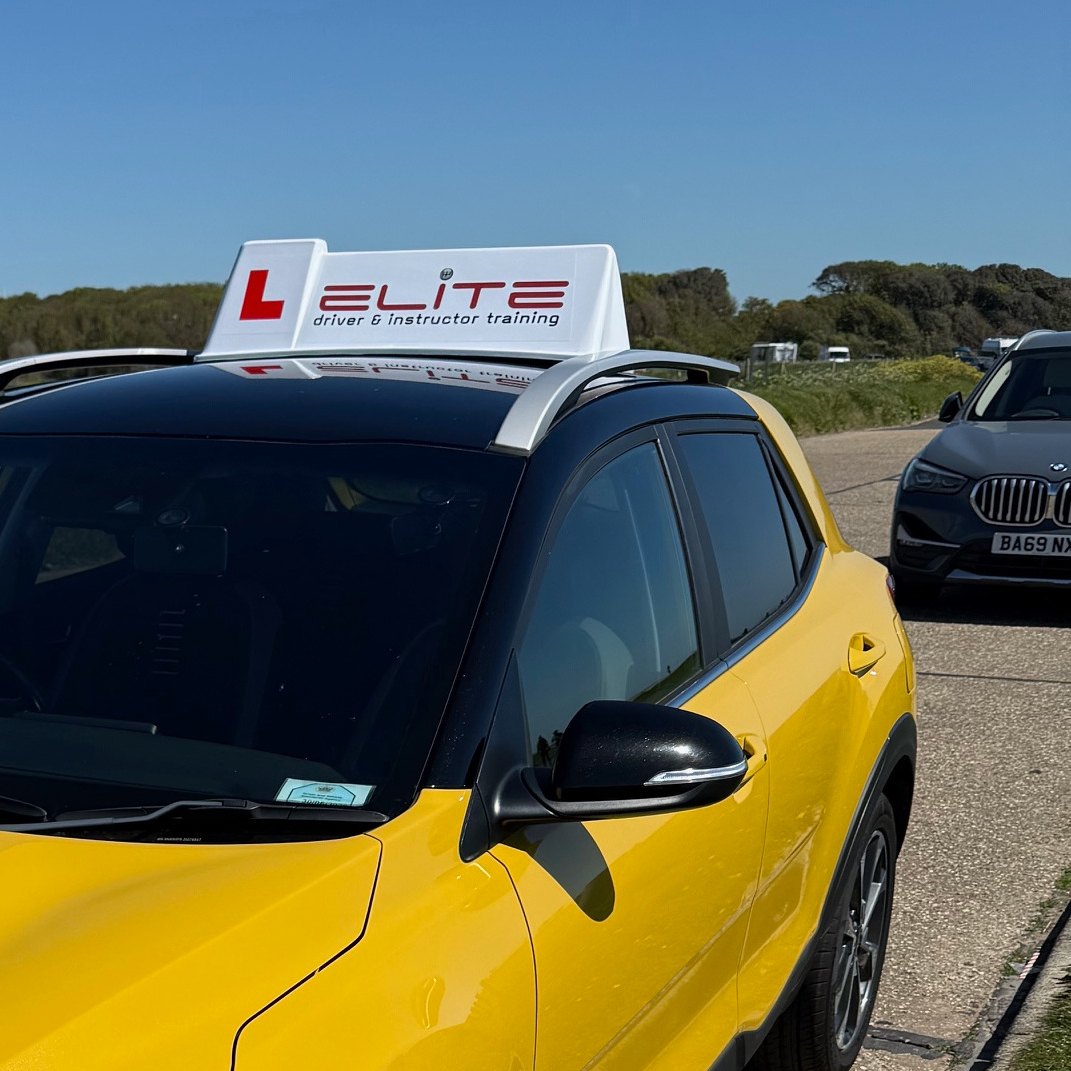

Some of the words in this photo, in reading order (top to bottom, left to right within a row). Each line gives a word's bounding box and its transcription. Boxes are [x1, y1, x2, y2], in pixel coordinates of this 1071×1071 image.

[239, 269, 285, 321] L
[313, 314, 364, 326] driver
[371, 314, 381, 326] &
[388, 312, 480, 326] instructor
[486, 311, 560, 328] training
[1000, 535, 1047, 551] BA69
